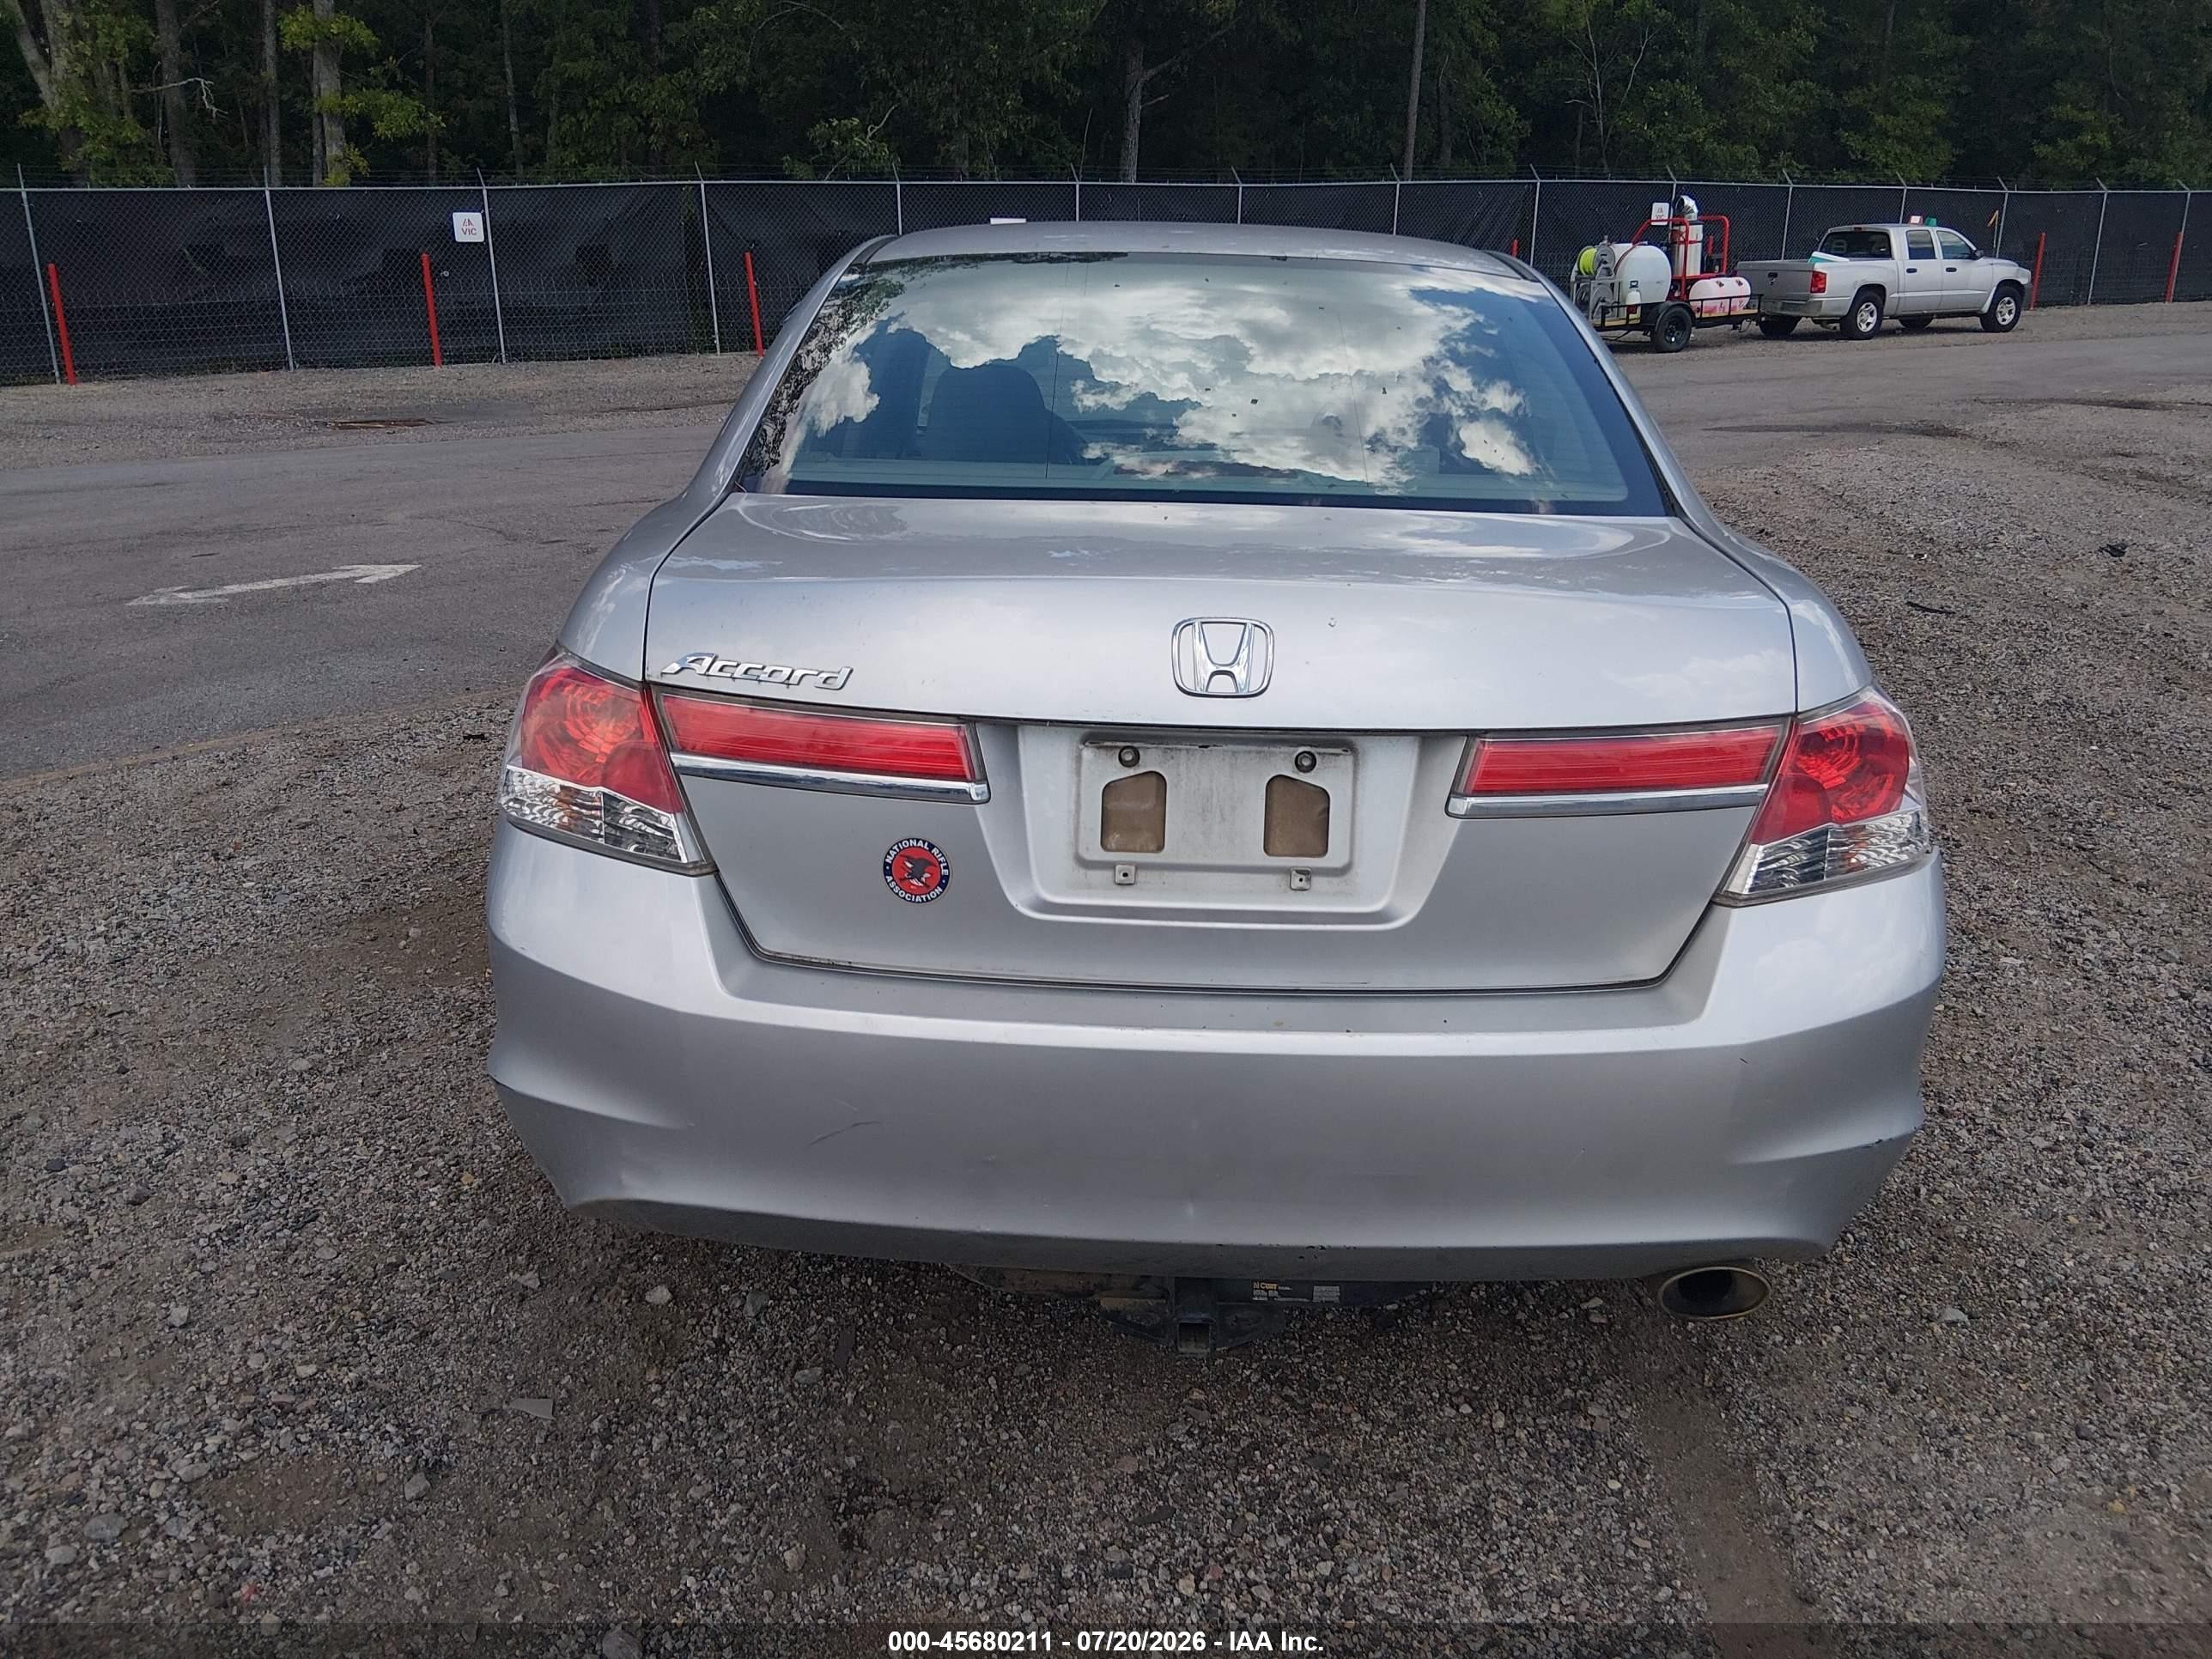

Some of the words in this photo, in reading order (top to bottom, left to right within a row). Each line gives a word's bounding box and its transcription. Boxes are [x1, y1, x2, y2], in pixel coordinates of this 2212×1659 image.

[660, 652, 854, 690] Accord
[884, 839, 930, 864] NATIONAL
[931, 847, 949, 876] RIFLE
[885, 875, 943, 902] ASSOCIATION
